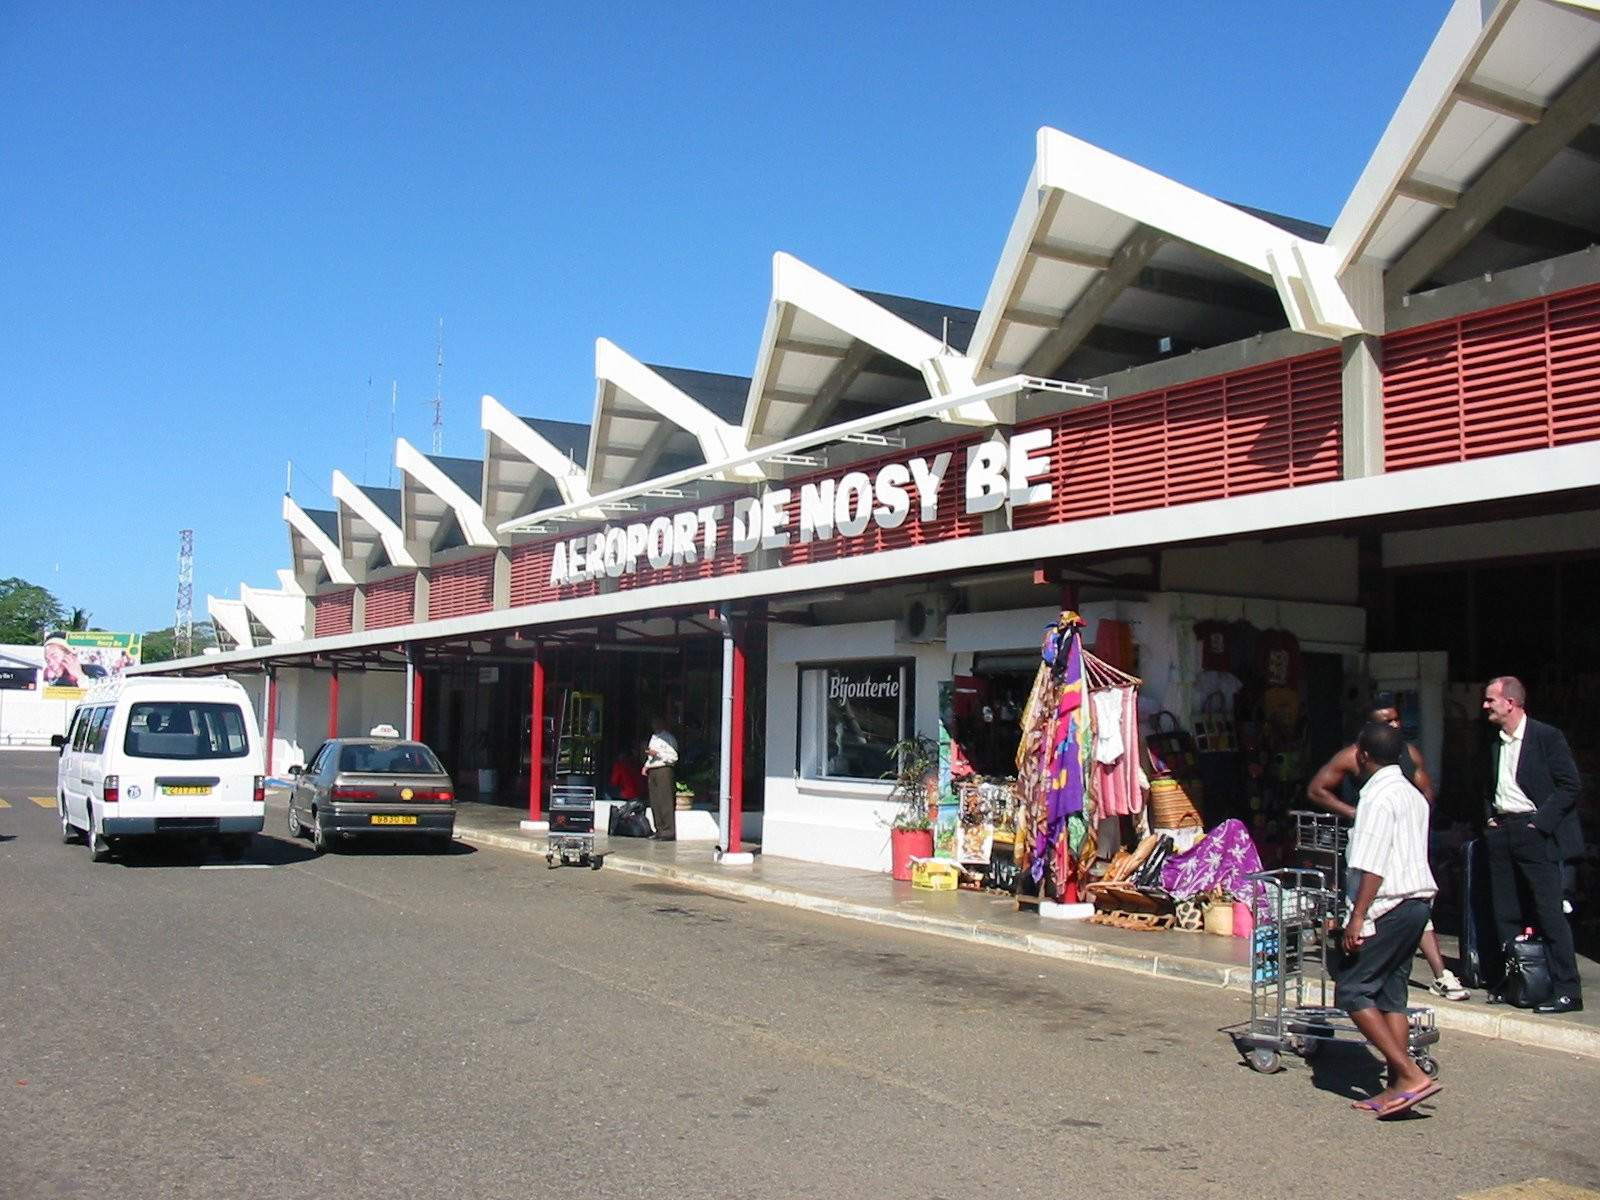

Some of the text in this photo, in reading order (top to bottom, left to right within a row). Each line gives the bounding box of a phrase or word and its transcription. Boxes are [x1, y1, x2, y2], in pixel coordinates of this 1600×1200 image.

[550, 428, 1053, 587] AEROPORT DE NOSY BE
[829, 674, 899, 706] Bijouterie
